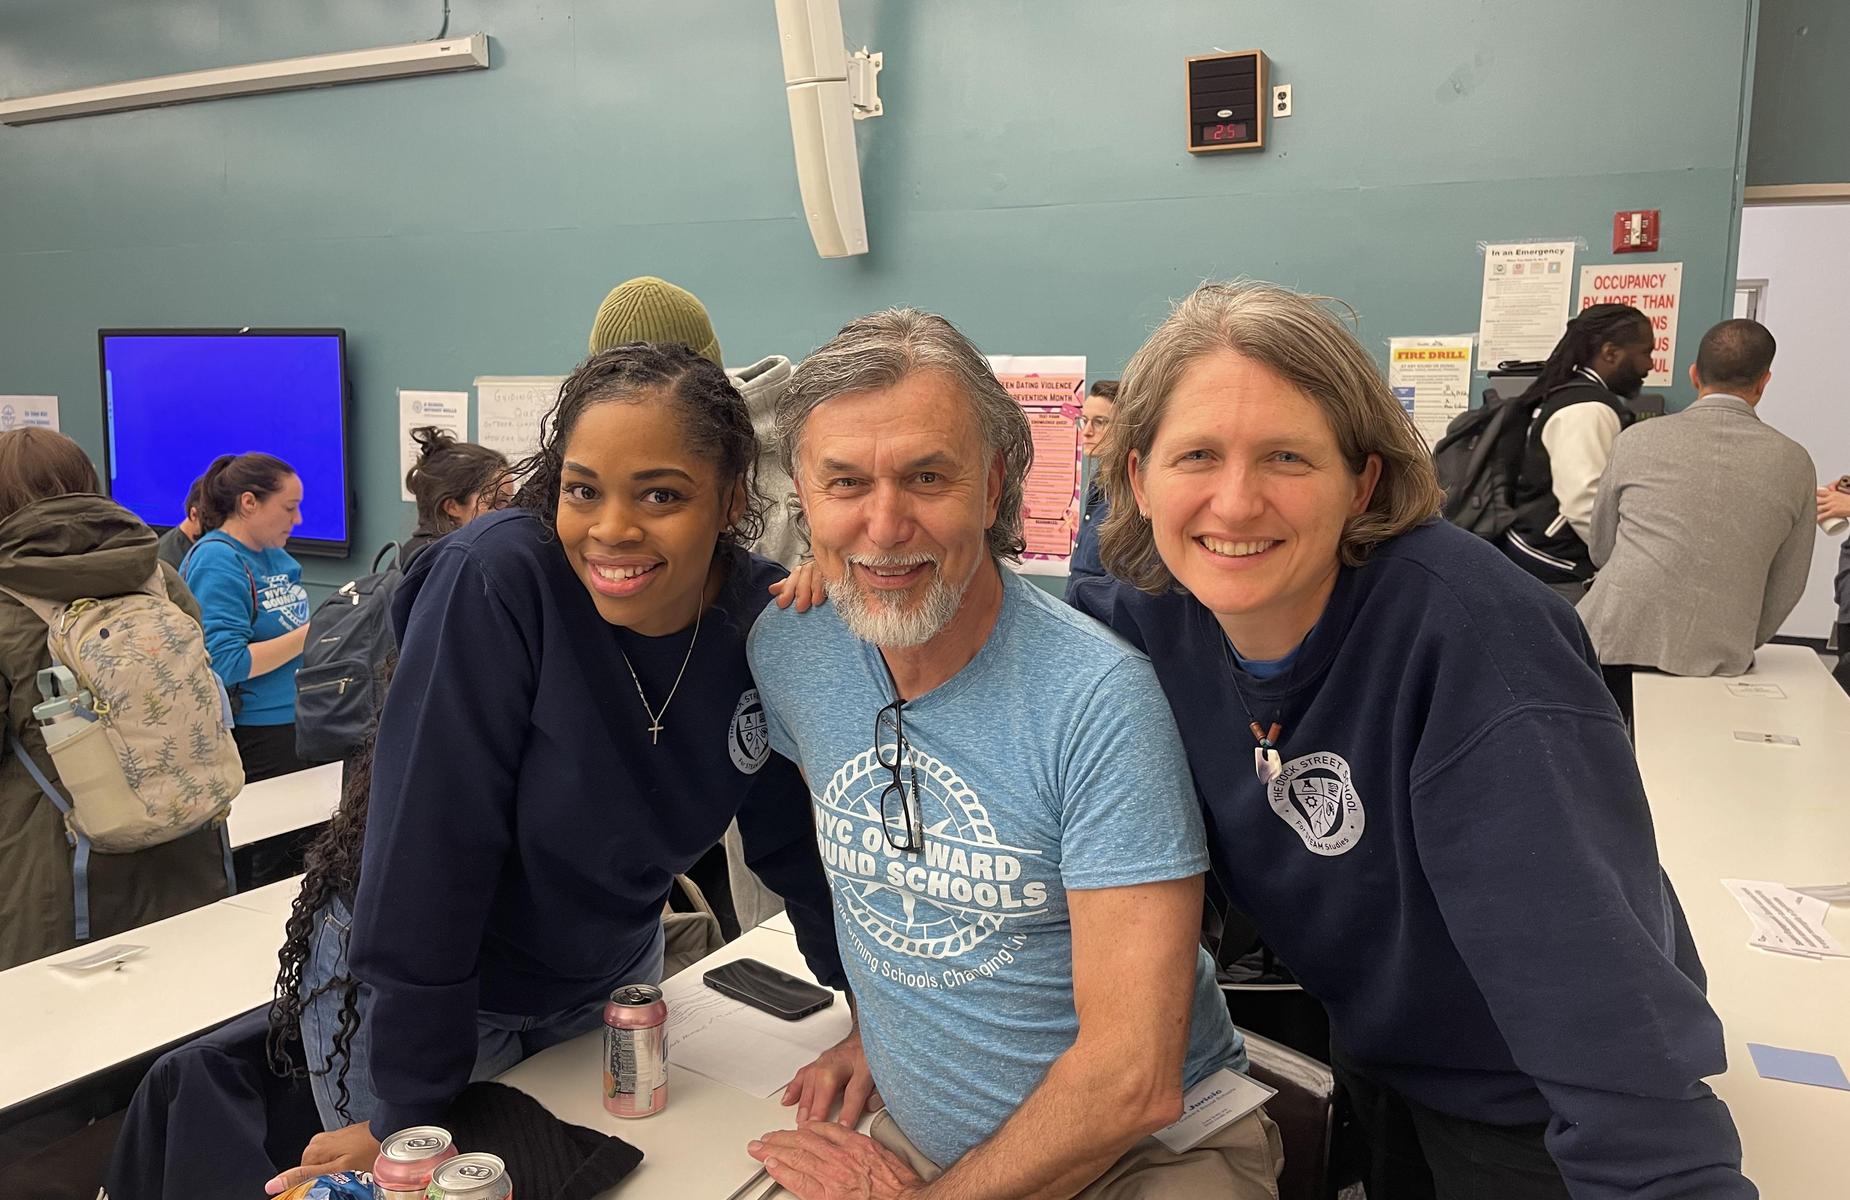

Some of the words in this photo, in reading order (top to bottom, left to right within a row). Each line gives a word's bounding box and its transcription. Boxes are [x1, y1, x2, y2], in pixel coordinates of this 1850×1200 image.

[1515, 248, 1565, 256] Emergency
[1593, 274, 1666, 290] OCCUPANCY
[1583, 296, 1598, 309] BY
[1604, 295, 1637, 307] MORE
[1643, 294, 1675, 309] THAN
[1397, 351, 1426, 359] FIRE
[1428, 351, 1465, 359] DRILL
[1016, 381, 1039, 389] DATING
[1041, 381, 1072, 389] VIOLENCE
[1050, 394, 1073, 402] MONTH
[262, 594, 296, 609] BOUND
[1300, 756, 1343, 770] STREET
[1277, 765, 1300, 788] DOCK
[1274, 786, 1284, 802] THE
[1342, 770, 1357, 814] SCHOOL
[815, 804, 853, 844] NYC
[1296, 820, 1306, 832] For
[1325, 838, 1349, 850] Studies
[816, 830, 876, 877] OUND
[886, 861, 1048, 909] SCHOOLS
[881, 960, 944, 989] Schools,
[942, 949, 1014, 988] Changing
